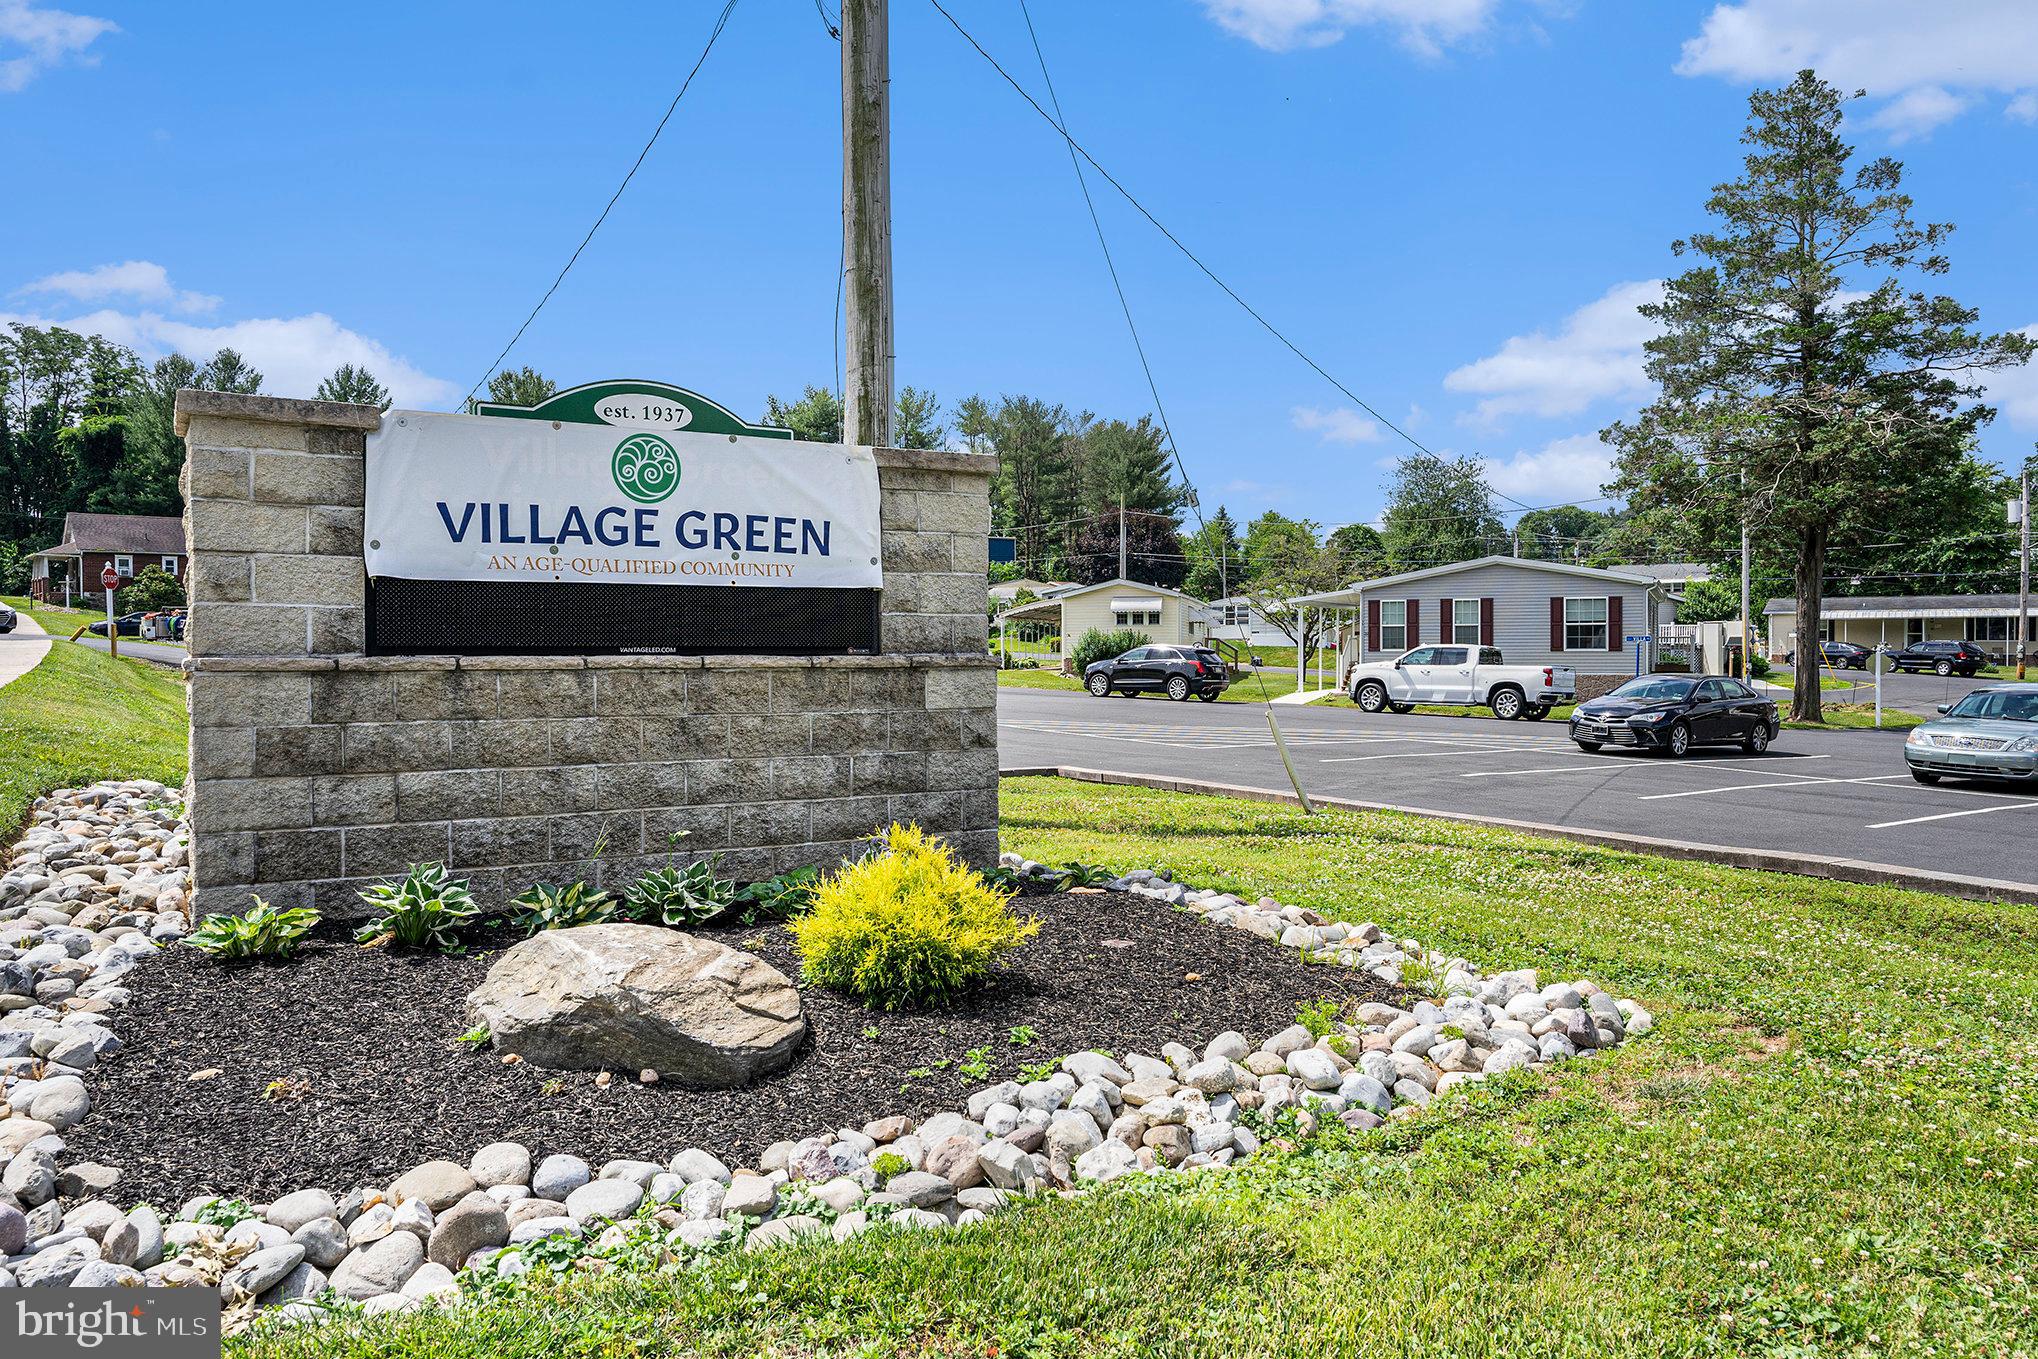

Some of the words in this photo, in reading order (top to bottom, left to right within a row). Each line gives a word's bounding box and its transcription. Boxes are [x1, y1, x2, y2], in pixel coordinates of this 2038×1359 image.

[603, 406, 636, 419] est.
[643, 406, 685, 423] 1937
[436, 501, 660, 547] VILLAGE
[675, 510, 830, 556] GREEN
[487, 556, 516, 570] AN
[522, 557, 676, 576] AGE-QUALIFIED
[681, 561, 796, 578] COMMUNITY
[104, 574, 118, 583] STOP
